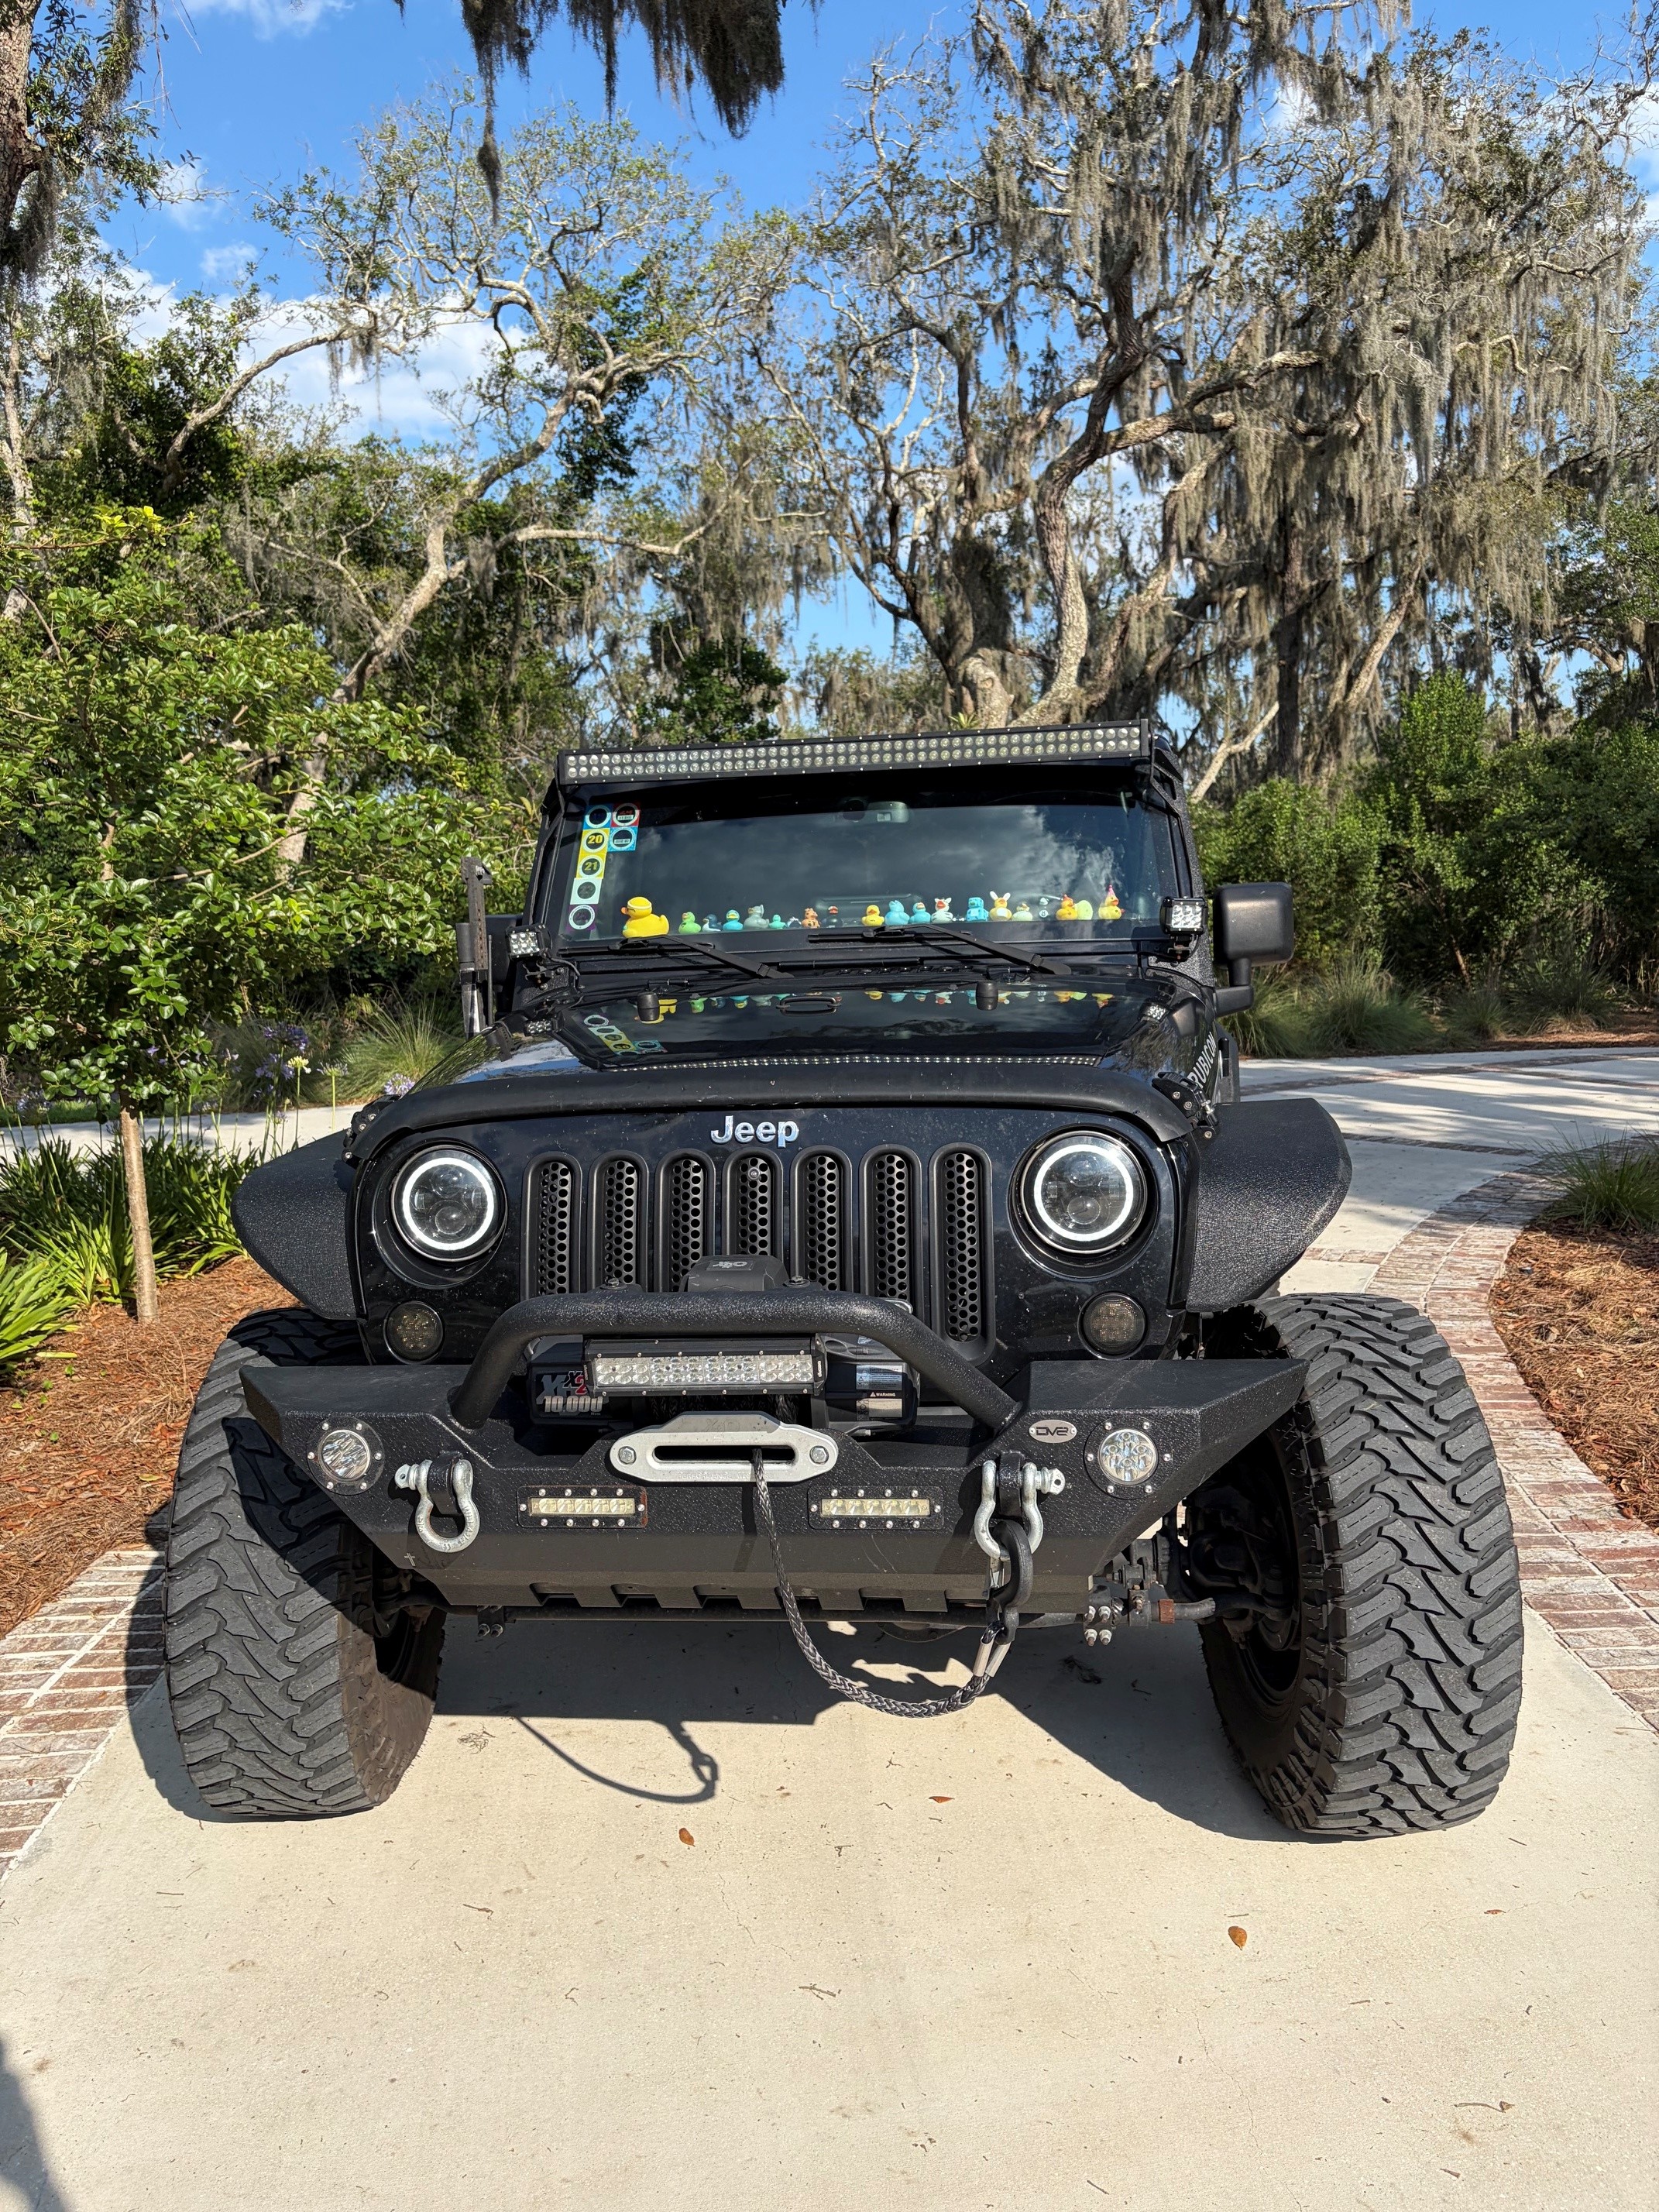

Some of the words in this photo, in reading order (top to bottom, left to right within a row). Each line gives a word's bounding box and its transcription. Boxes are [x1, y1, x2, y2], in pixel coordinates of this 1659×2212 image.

[587, 834, 603, 844] 20
[584, 861, 598, 871] 21
[1187, 1031, 1218, 1089] RUBICON
[710, 1115, 799, 1148] Jeep
[677, 1471, 732, 1480] PERFORMANCE
